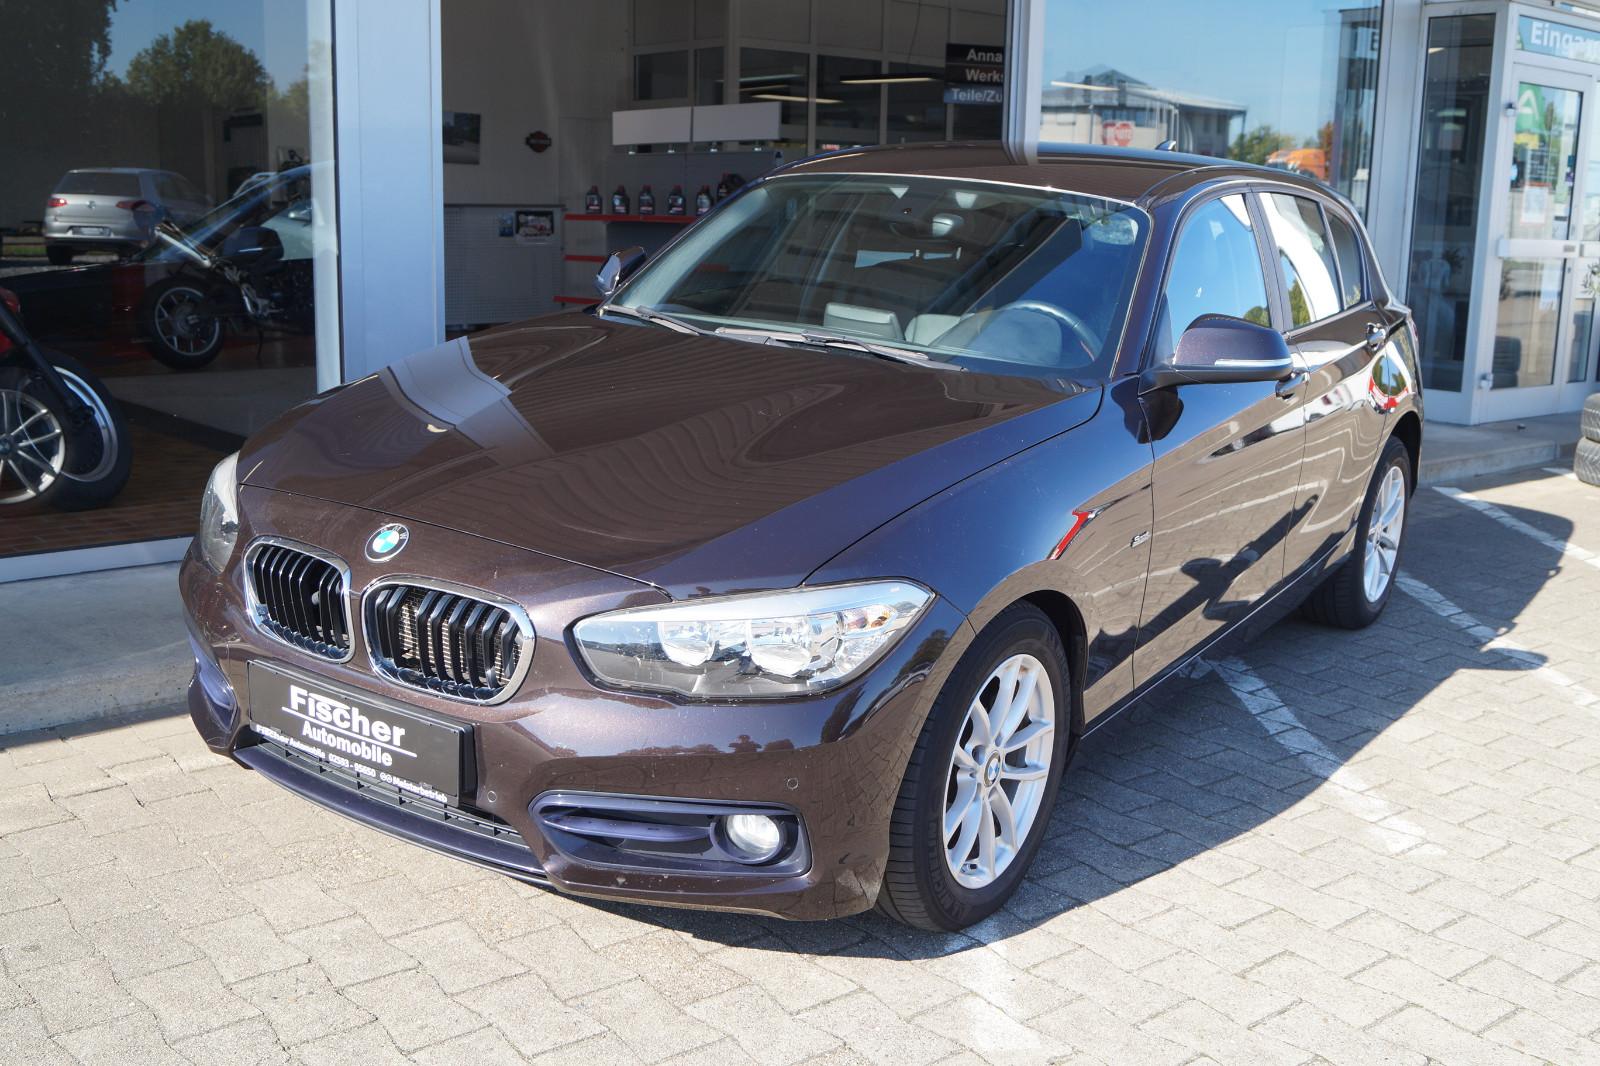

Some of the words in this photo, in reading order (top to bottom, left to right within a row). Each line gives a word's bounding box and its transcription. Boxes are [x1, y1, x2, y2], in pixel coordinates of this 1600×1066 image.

[966, 48, 1003, 63] Anna
[1530, 20, 1600, 56] Einga
[951, 88, 1003, 104] Teile/Zu
[289, 684, 406, 748] Fischer
[301, 720, 393, 767] Automobile
